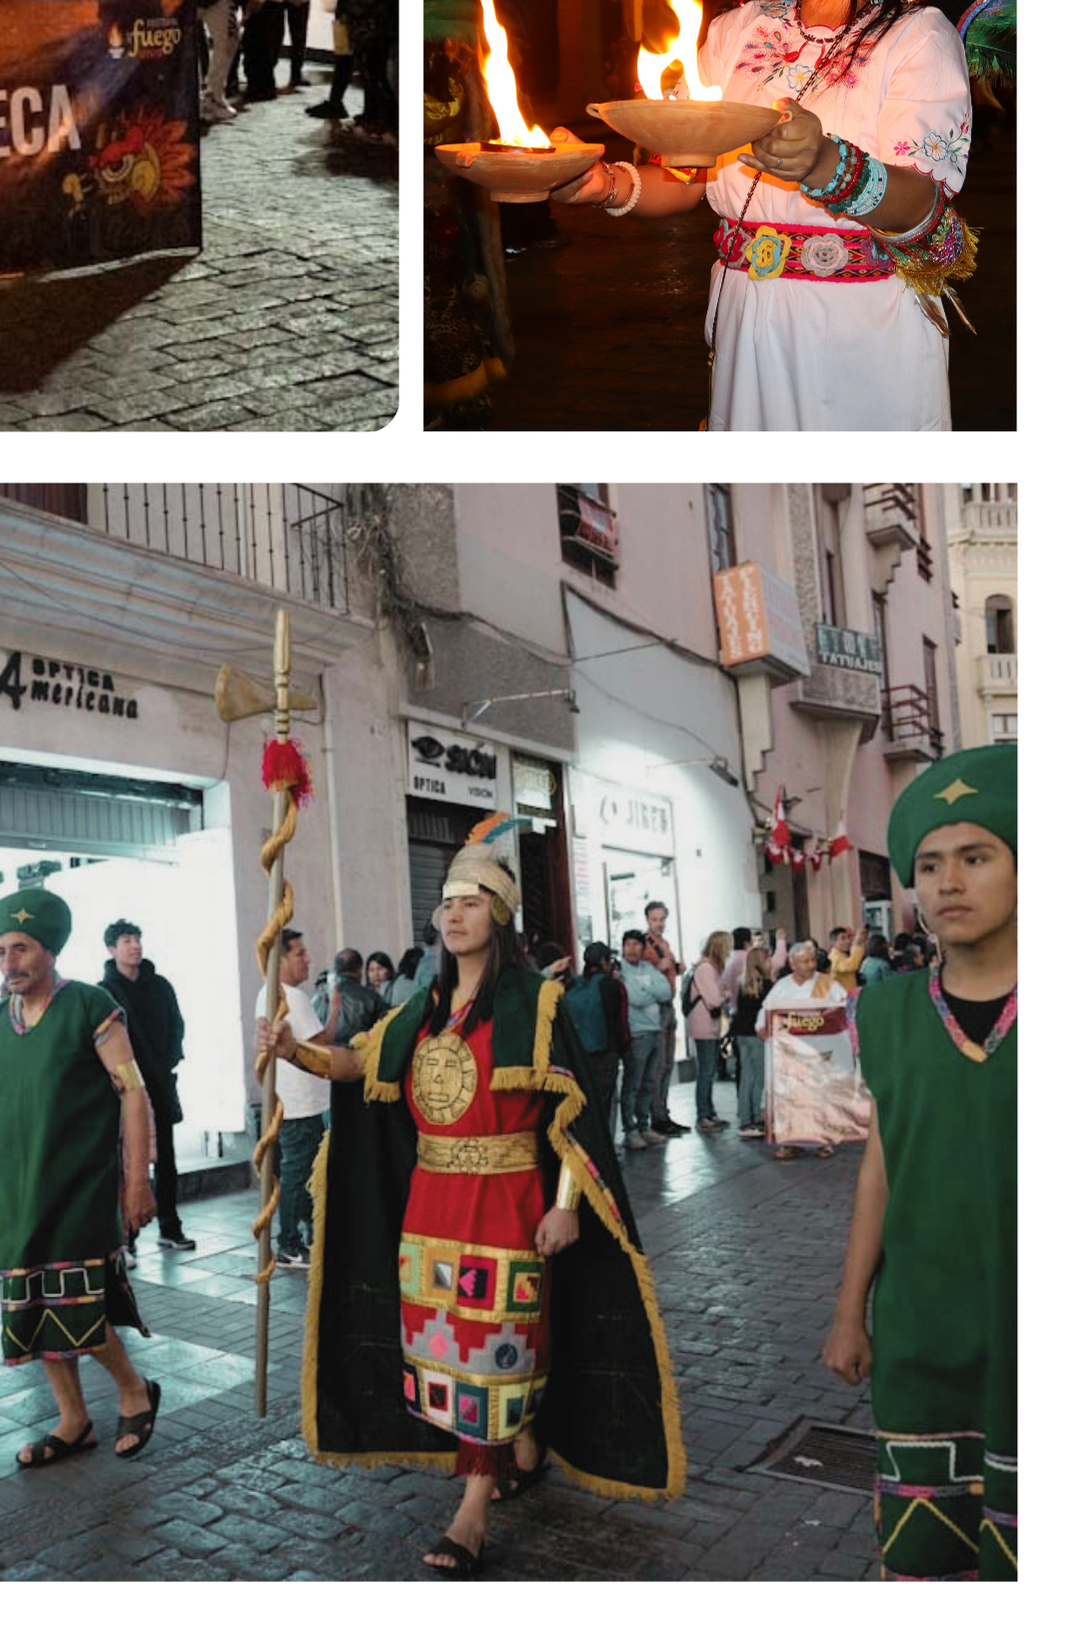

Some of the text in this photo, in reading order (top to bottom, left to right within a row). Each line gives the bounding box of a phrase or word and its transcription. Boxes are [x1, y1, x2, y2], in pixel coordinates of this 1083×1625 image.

[128, 19, 182, 57] fuego
[32, 658, 114, 692] OPTICA
[414, 776, 446, 794] OPTICA
[786, 1011, 825, 1031] fuego
